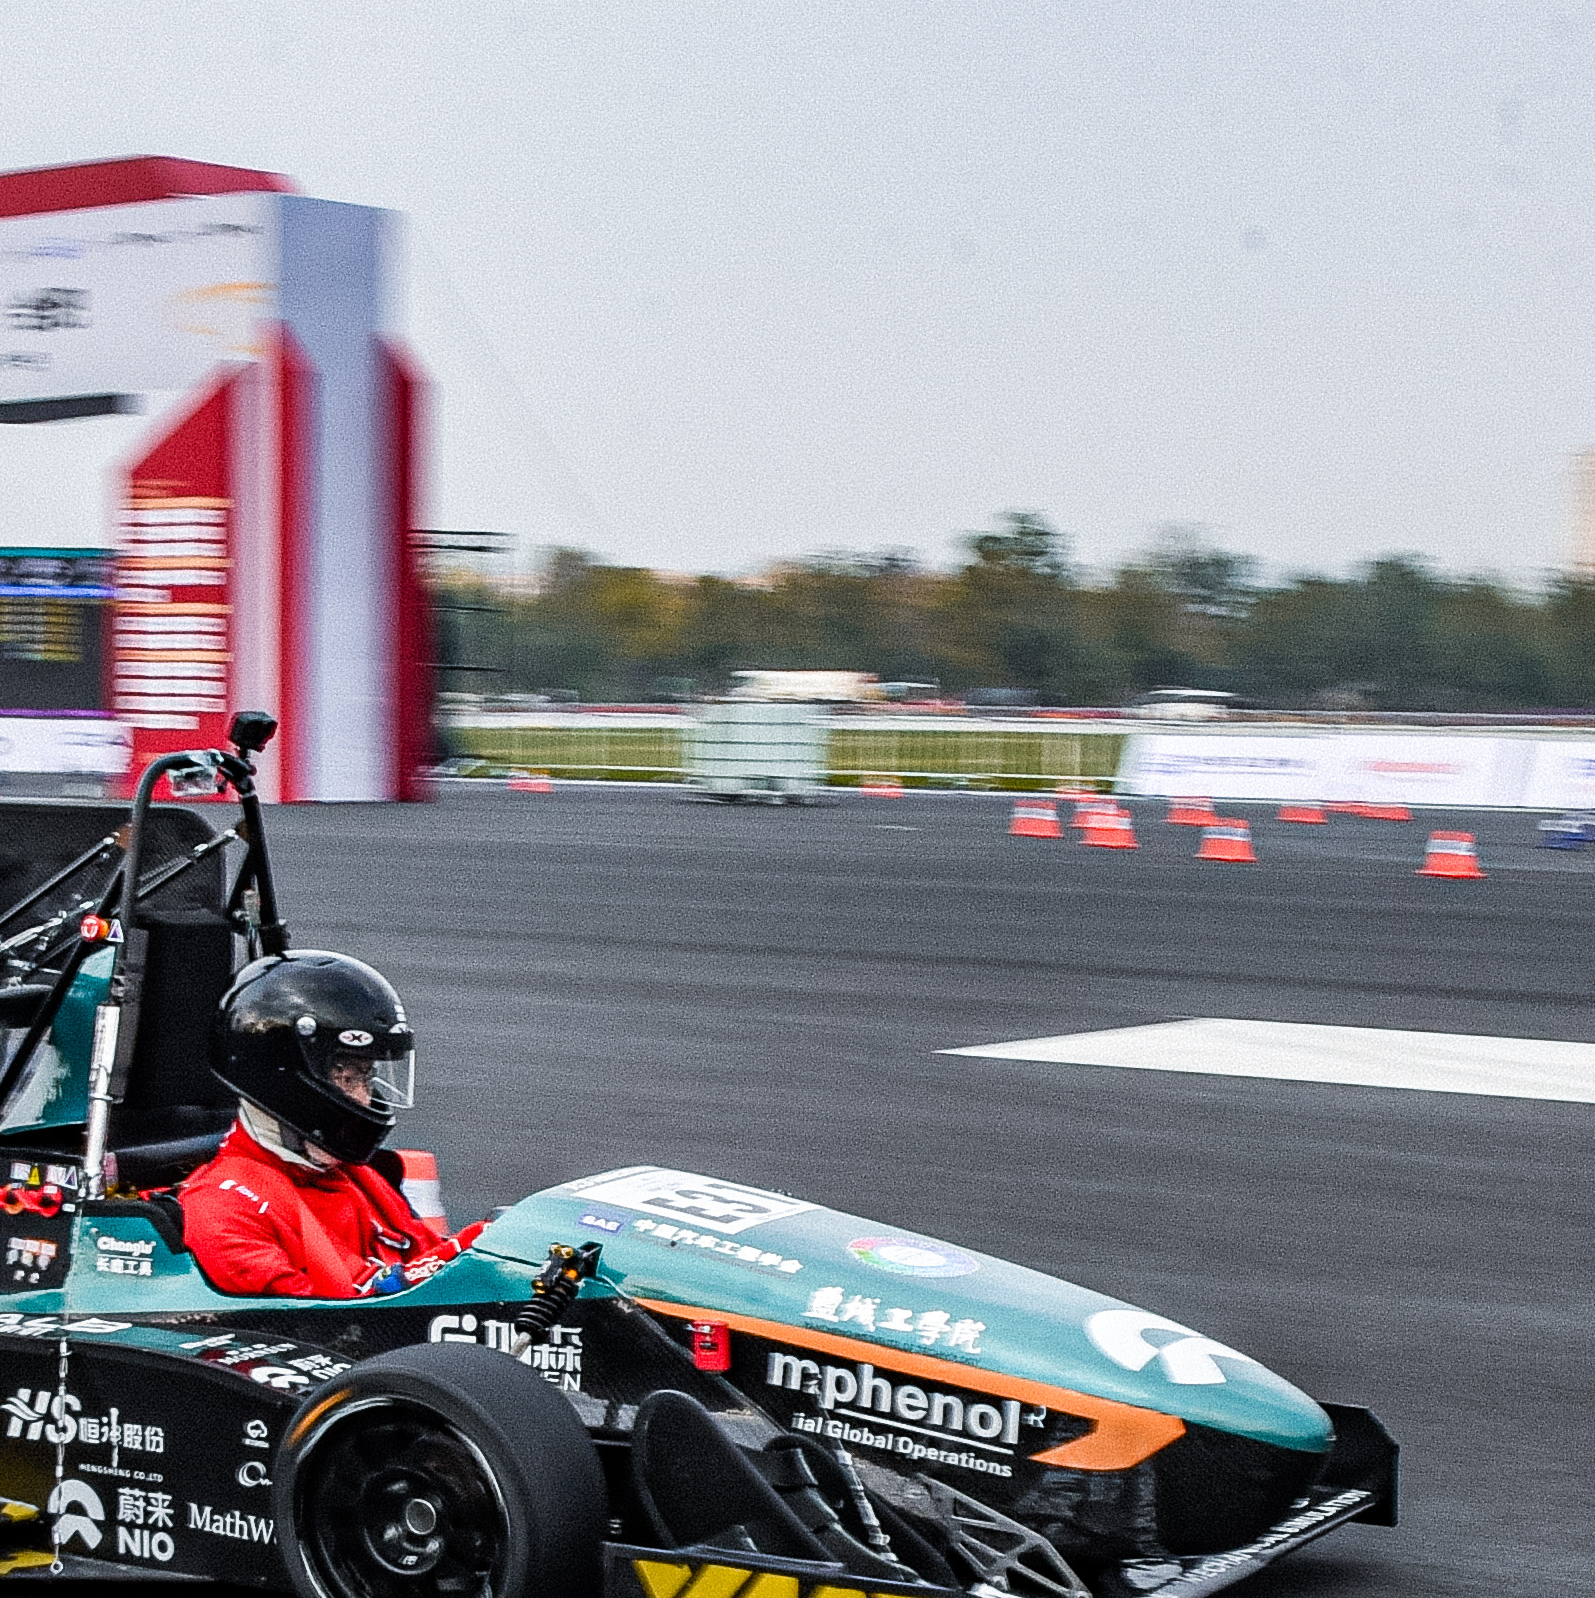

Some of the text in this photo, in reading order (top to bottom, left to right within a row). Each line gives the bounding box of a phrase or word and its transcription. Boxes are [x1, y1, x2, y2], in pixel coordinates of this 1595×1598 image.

[823, 1419, 893, 1450] Global
[897, 1437, 1013, 1477] Operations
[117, 1487, 174, 1528] 蔚来
[188, 1502, 277, 1545] MathW
[117, 1526, 175, 1562] NIO
